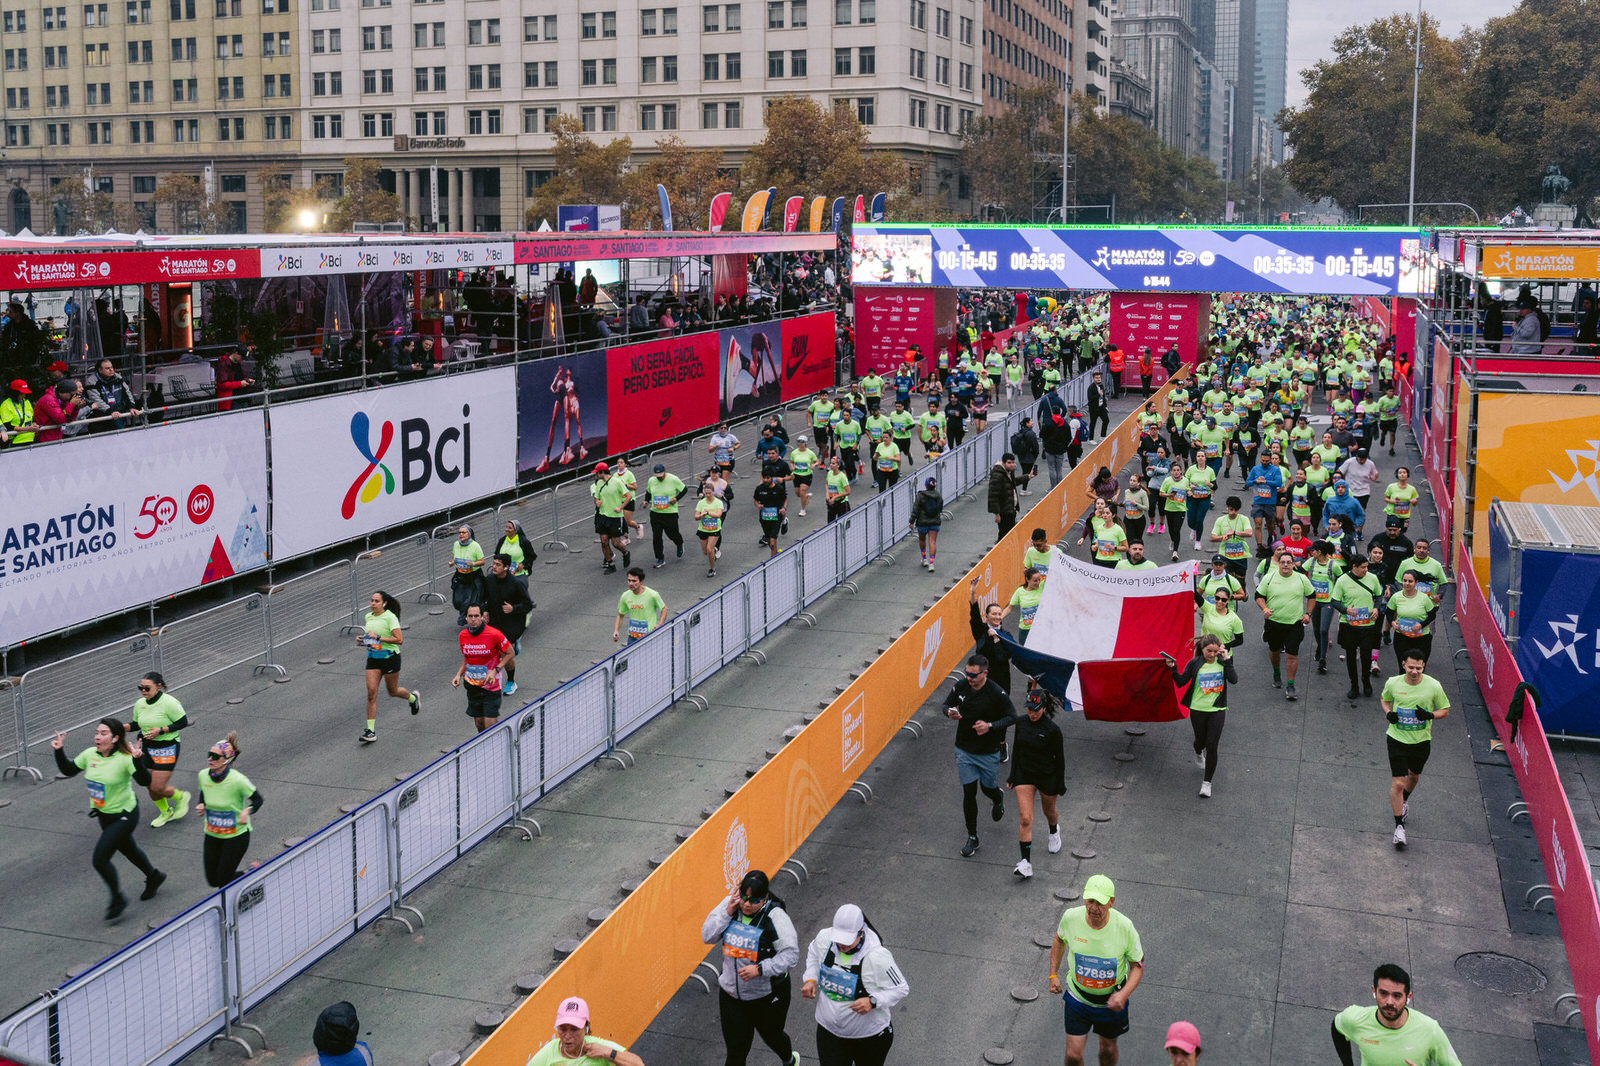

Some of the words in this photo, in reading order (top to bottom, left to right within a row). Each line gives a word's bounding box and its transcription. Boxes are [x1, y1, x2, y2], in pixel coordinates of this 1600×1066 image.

[410, 137, 466, 149] BancoEstado
[492, 248, 502, 260] Bci
[533, 245, 573, 259] SANTIAGO
[611, 242, 644, 255] SANTIAGO
[1111, 248, 1165, 259] MARATÓN
[172, 257, 208, 268] MARATÓN
[287, 255, 302, 270] Bci
[328, 254, 342, 267] Bci
[366, 253, 378, 266] Bci
[400, 252, 412, 264] Bci
[433, 250, 444, 263] Bci
[463, 250, 474, 262] Bci
[939, 251, 997, 271] 00:15:45
[1010, 252, 1066, 271] 00:35:35
[1123, 258, 1165, 266] SANTIAGO
[1515, 254, 1575, 265] MARATÓN
[30, 261, 75, 273] MARATÓN
[80, 262, 97, 277] 50
[1253, 255, 1314, 274] 00:35:35
[1325, 255, 1395, 277] 00:15:45
[1529, 264, 1575, 272] SANTIAGO
[31, 273, 41, 281] DE
[41, 271, 76, 280] SANTIAGO
[631, 355, 645, 375] NO
[647, 346, 672, 371] SERÁ
[623, 373, 650, 396] PERO
[401, 403, 471, 496] Bci
[133, 494, 178, 539] 50
[12, 531, 116, 574] SANTIAGO
[46, 559, 93, 575] HISTORIAS
[98, 554, 107, 562] 50
[111, 547, 134, 558] AÑOS
[138, 539, 164, 550] METRO
[167, 535, 176, 543] DE
[180, 525, 216, 540] SANTIAGO
[923, 616, 942, 661] RUN
[1077, 964, 1115, 979] 37889
[820, 975, 853, 996] 32352
